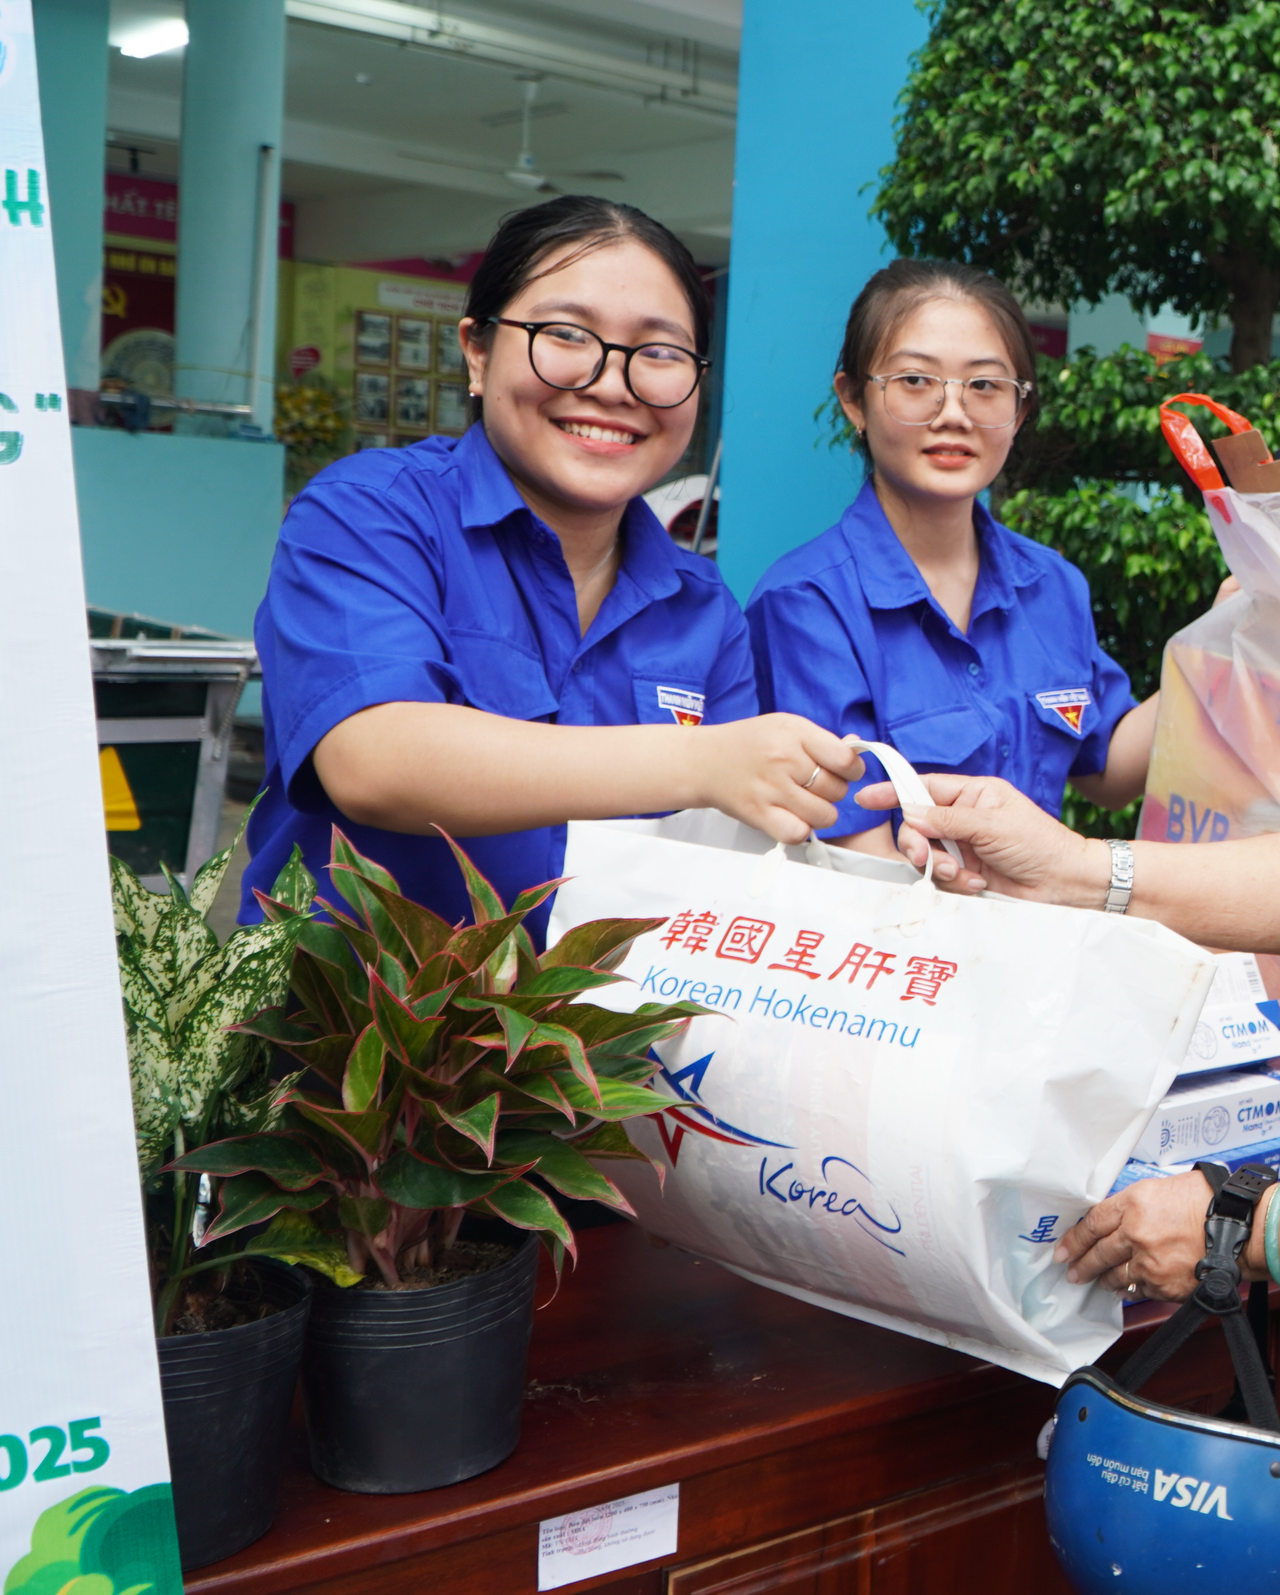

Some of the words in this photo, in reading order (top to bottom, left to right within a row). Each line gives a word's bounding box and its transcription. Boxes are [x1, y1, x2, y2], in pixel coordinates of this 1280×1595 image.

[659, 909, 958, 1007] 韓國星肝寶
[639, 965, 743, 1010] Korean
[748, 989, 922, 1049] Hokenamu
[759, 1157, 901, 1234] Korea
[1153, 1468, 1234, 1521] VISA
